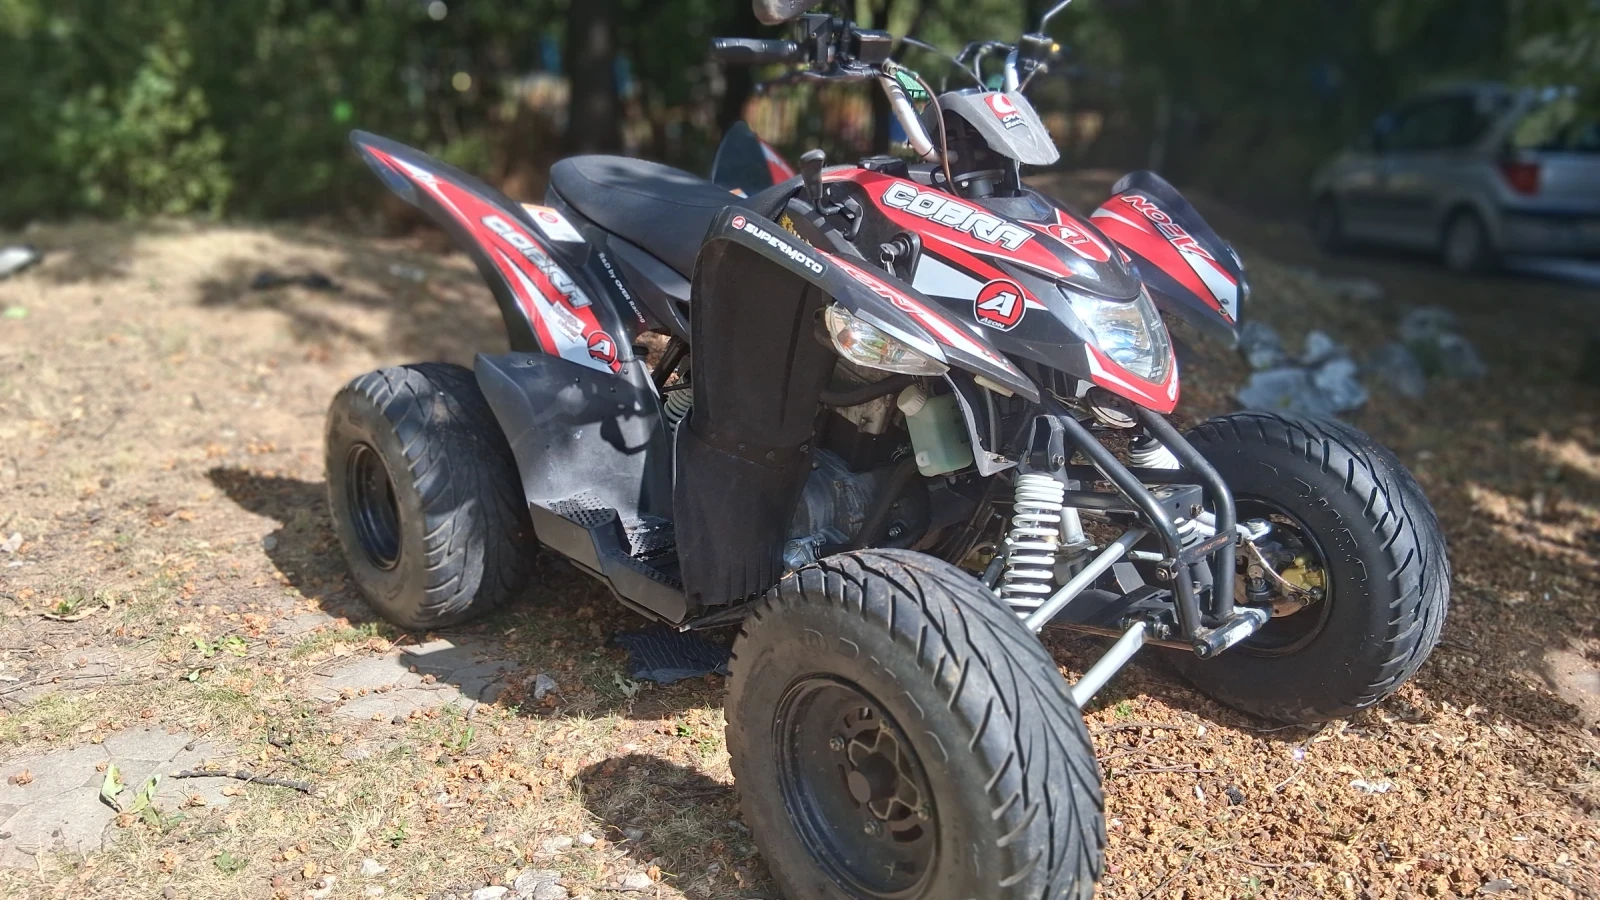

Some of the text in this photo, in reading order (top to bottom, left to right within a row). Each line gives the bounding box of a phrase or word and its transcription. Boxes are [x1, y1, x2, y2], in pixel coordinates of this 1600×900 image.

[744, 222, 823, 274] SUPERMOTO
[882, 181, 1036, 251] COBRA
[1121, 195, 1216, 261] AEON
[481, 215, 593, 309] COBRA
[608, 269, 617, 279] by
[615, 279, 631, 300] OVER
[628, 300, 646, 324] Racing
